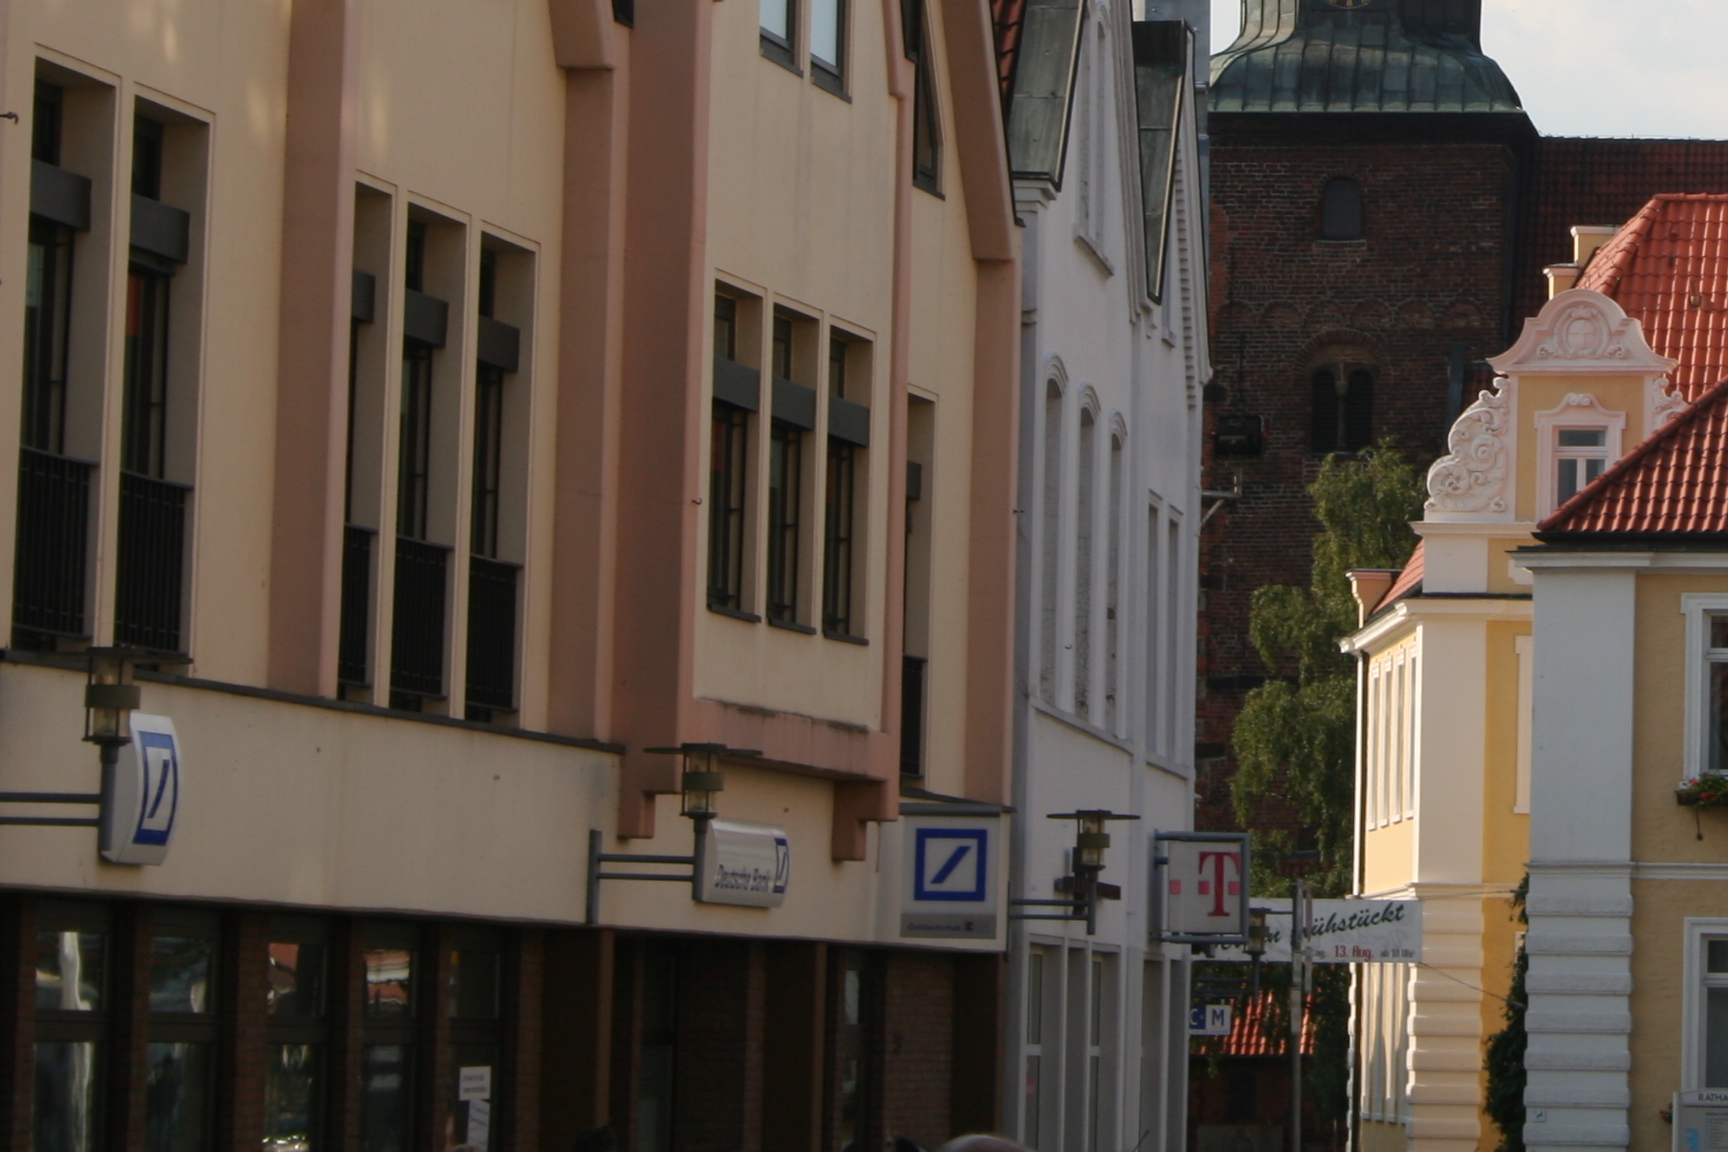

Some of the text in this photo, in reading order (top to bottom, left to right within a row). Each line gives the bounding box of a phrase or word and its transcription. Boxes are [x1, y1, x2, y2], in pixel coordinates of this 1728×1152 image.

[1199, 851, 1241, 917] T
[1303, 901, 1405, 937] ühstückt
[1335, 944, 1348, 958] 13.
[1352, 945, 1374, 962] Aug.
